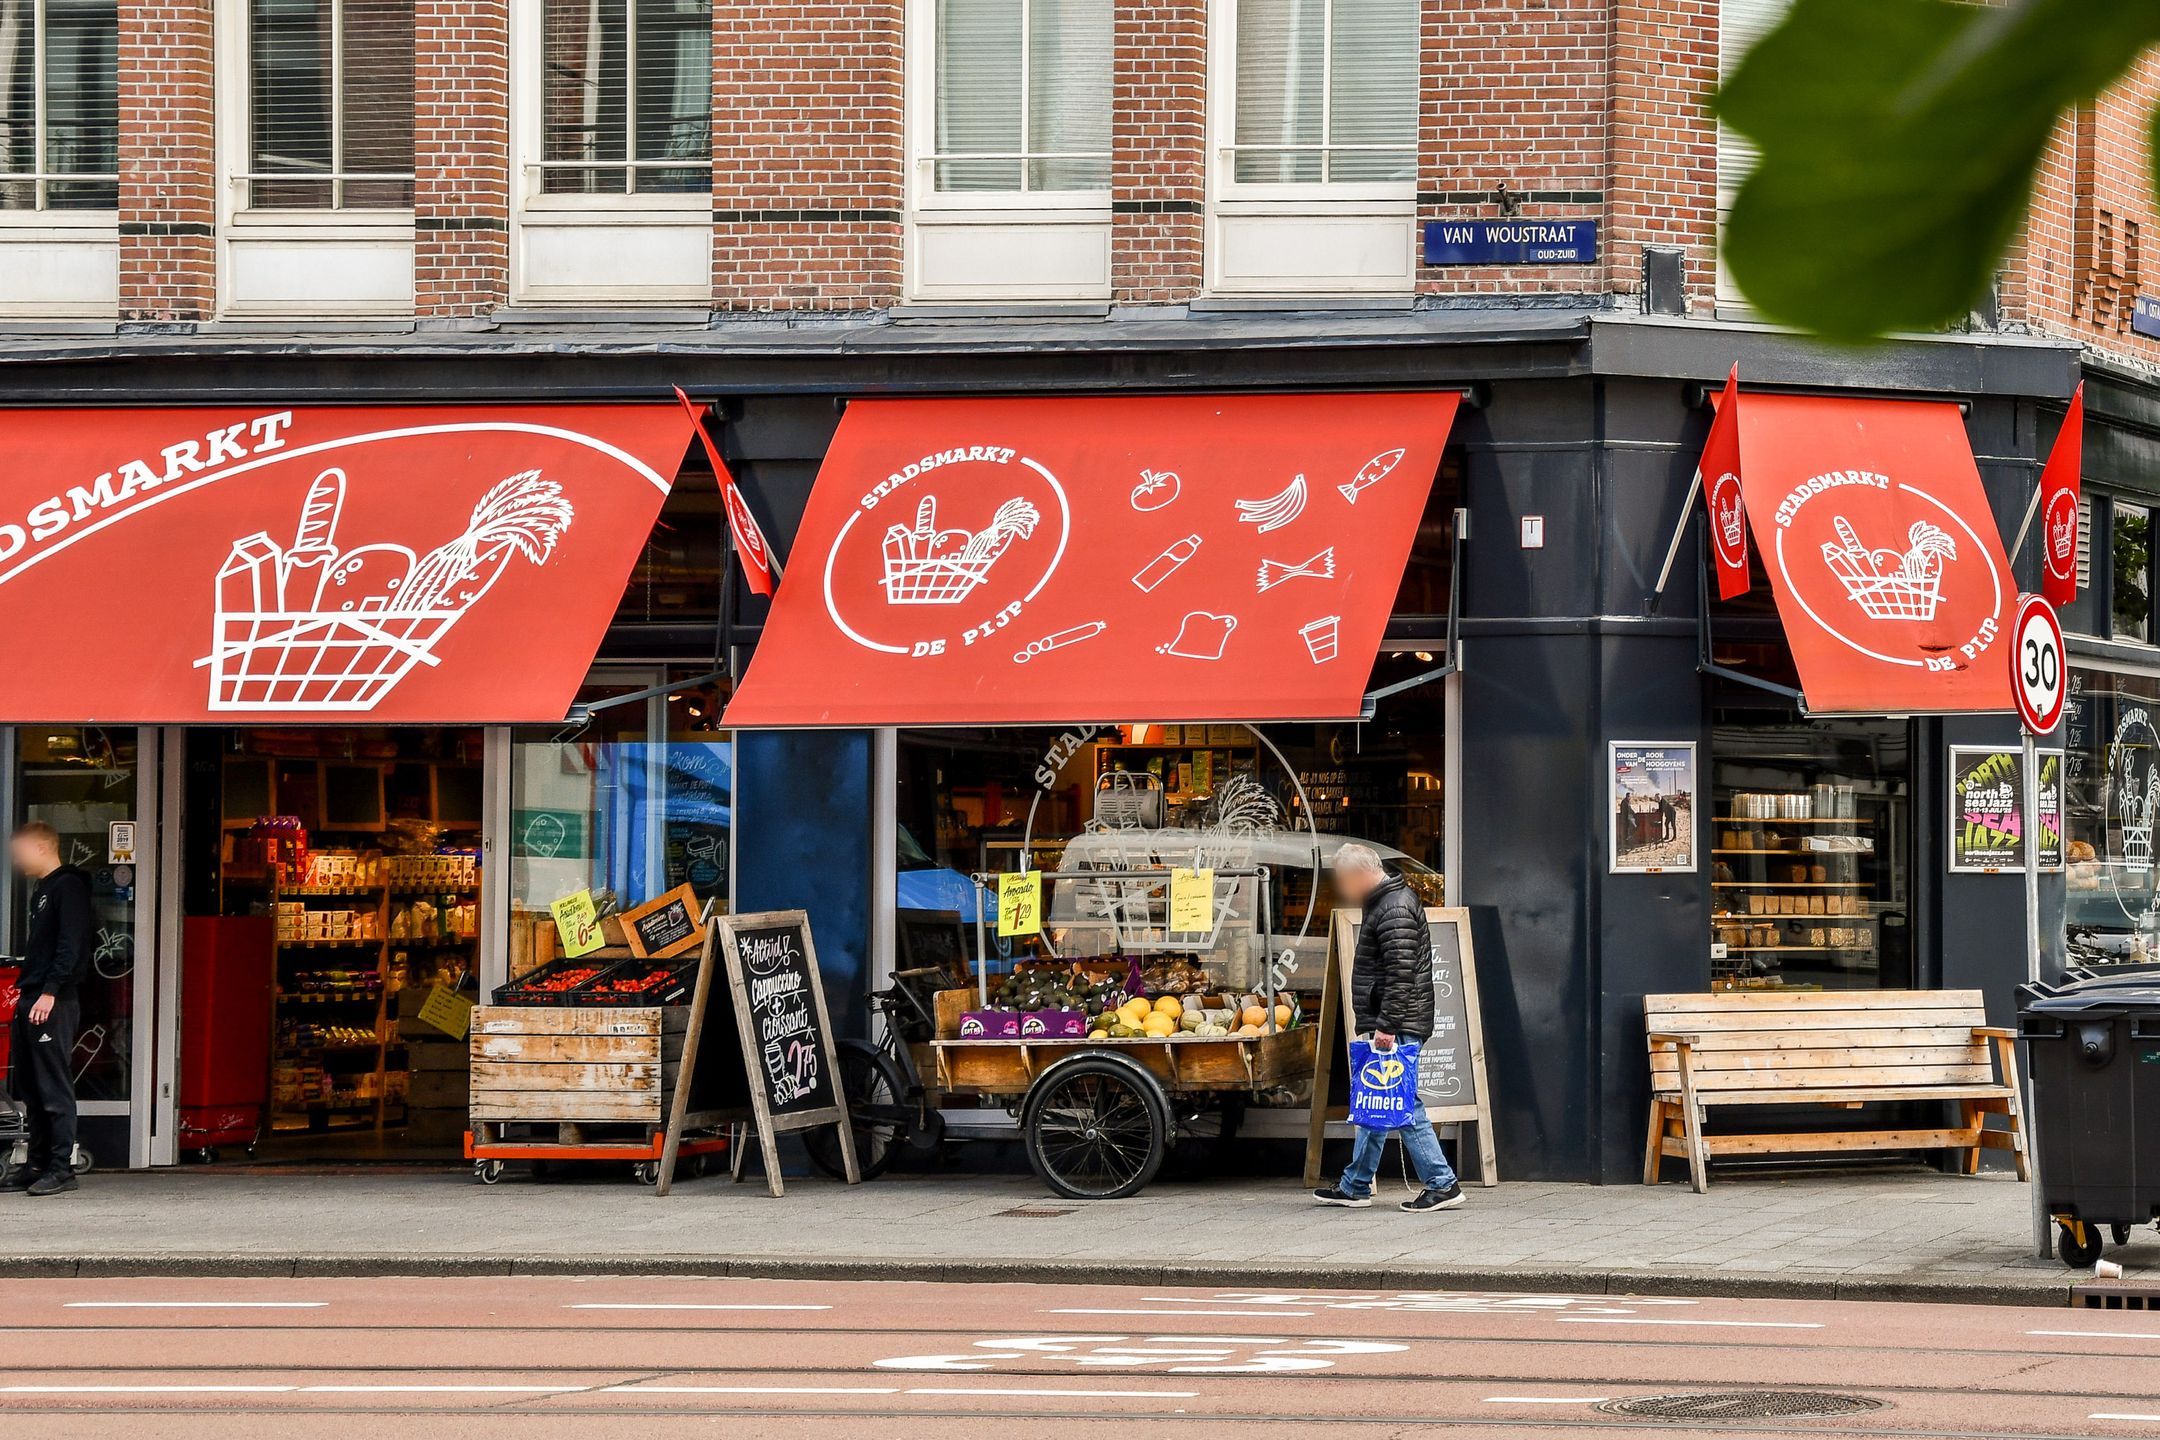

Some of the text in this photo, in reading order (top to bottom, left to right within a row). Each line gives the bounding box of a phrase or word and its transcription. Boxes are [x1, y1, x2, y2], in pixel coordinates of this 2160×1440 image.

[1443, 226, 1576, 243] VAN WOUSTRAAT
[1537, 249, 1576, 259] OUD-ZUID
[860, 445, 1016, 510] STADSMARKT
[1774, 470, 1891, 528] STADSMARKT
[912, 600, 1022, 657] DE PIJP
[1923, 617, 1999, 672] DE PIJP
[2025, 639, 2057, 692] 30
[1956, 753, 2016, 796] NORTH
[1966, 788, 1998, 799] north
[1964, 799, 1986, 808] sea
[1003, 882, 1034, 898] Avocado
[751, 969, 802, 1006] Cappuccino
[762, 1002, 808, 1042] croissant
[1355, 1091, 1403, 1110] Primera
